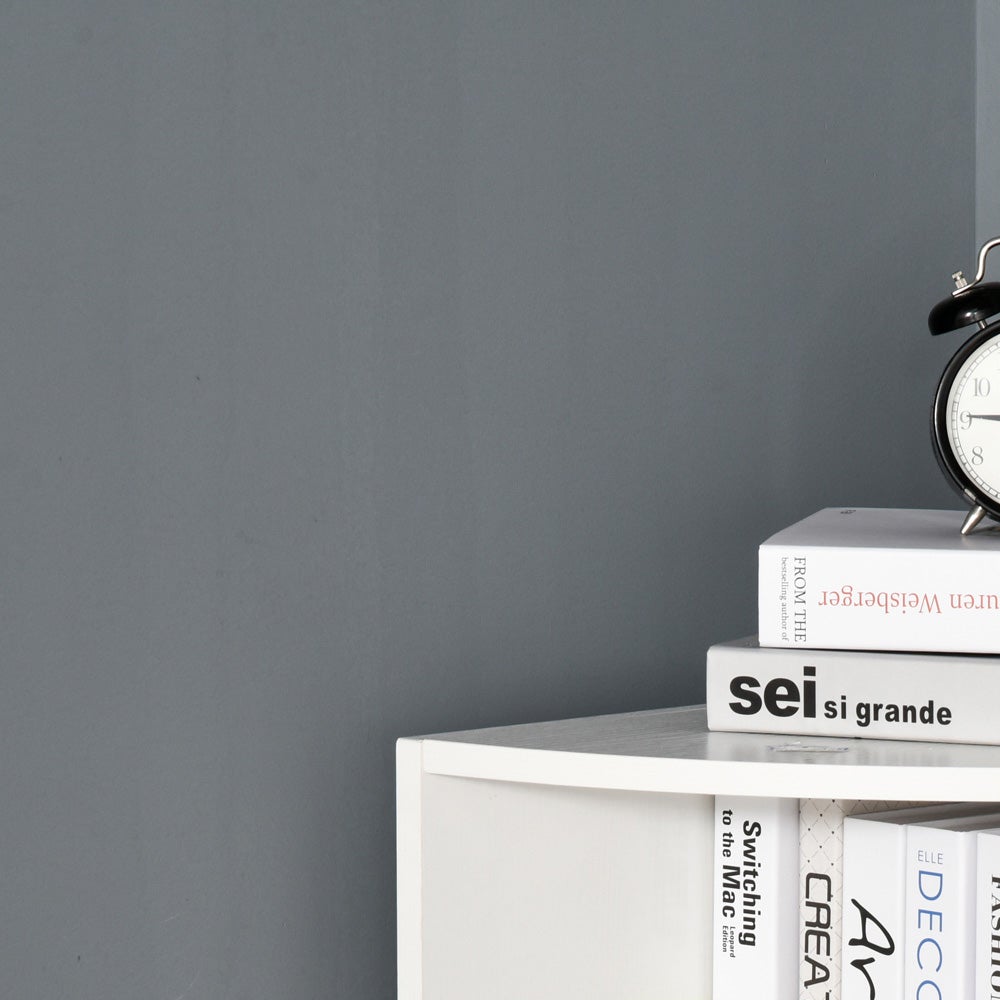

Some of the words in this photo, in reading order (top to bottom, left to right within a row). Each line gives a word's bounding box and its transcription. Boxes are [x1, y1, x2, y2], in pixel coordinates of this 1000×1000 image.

[972, 378, 991, 397] 10
[960, 411, 972, 430] 9
[972, 446, 984, 466] 8
[780, 557, 789, 600] bestselling
[794, 557, 806, 605] FROM
[818, 588, 942, 614] Weisberger
[782, 602, 790, 630] author
[794, 609, 806, 642] THE
[782, 632, 790, 642] of
[728, 666, 816, 718] sei
[824, 694, 848, 720] si
[855, 702, 952, 728] grande
[722, 809, 734, 826] to
[722, 832, 734, 858] the
[917, 850, 944, 865] ELLE
[722, 865, 741, 918] Mac
[738, 820, 762, 947] Switching
